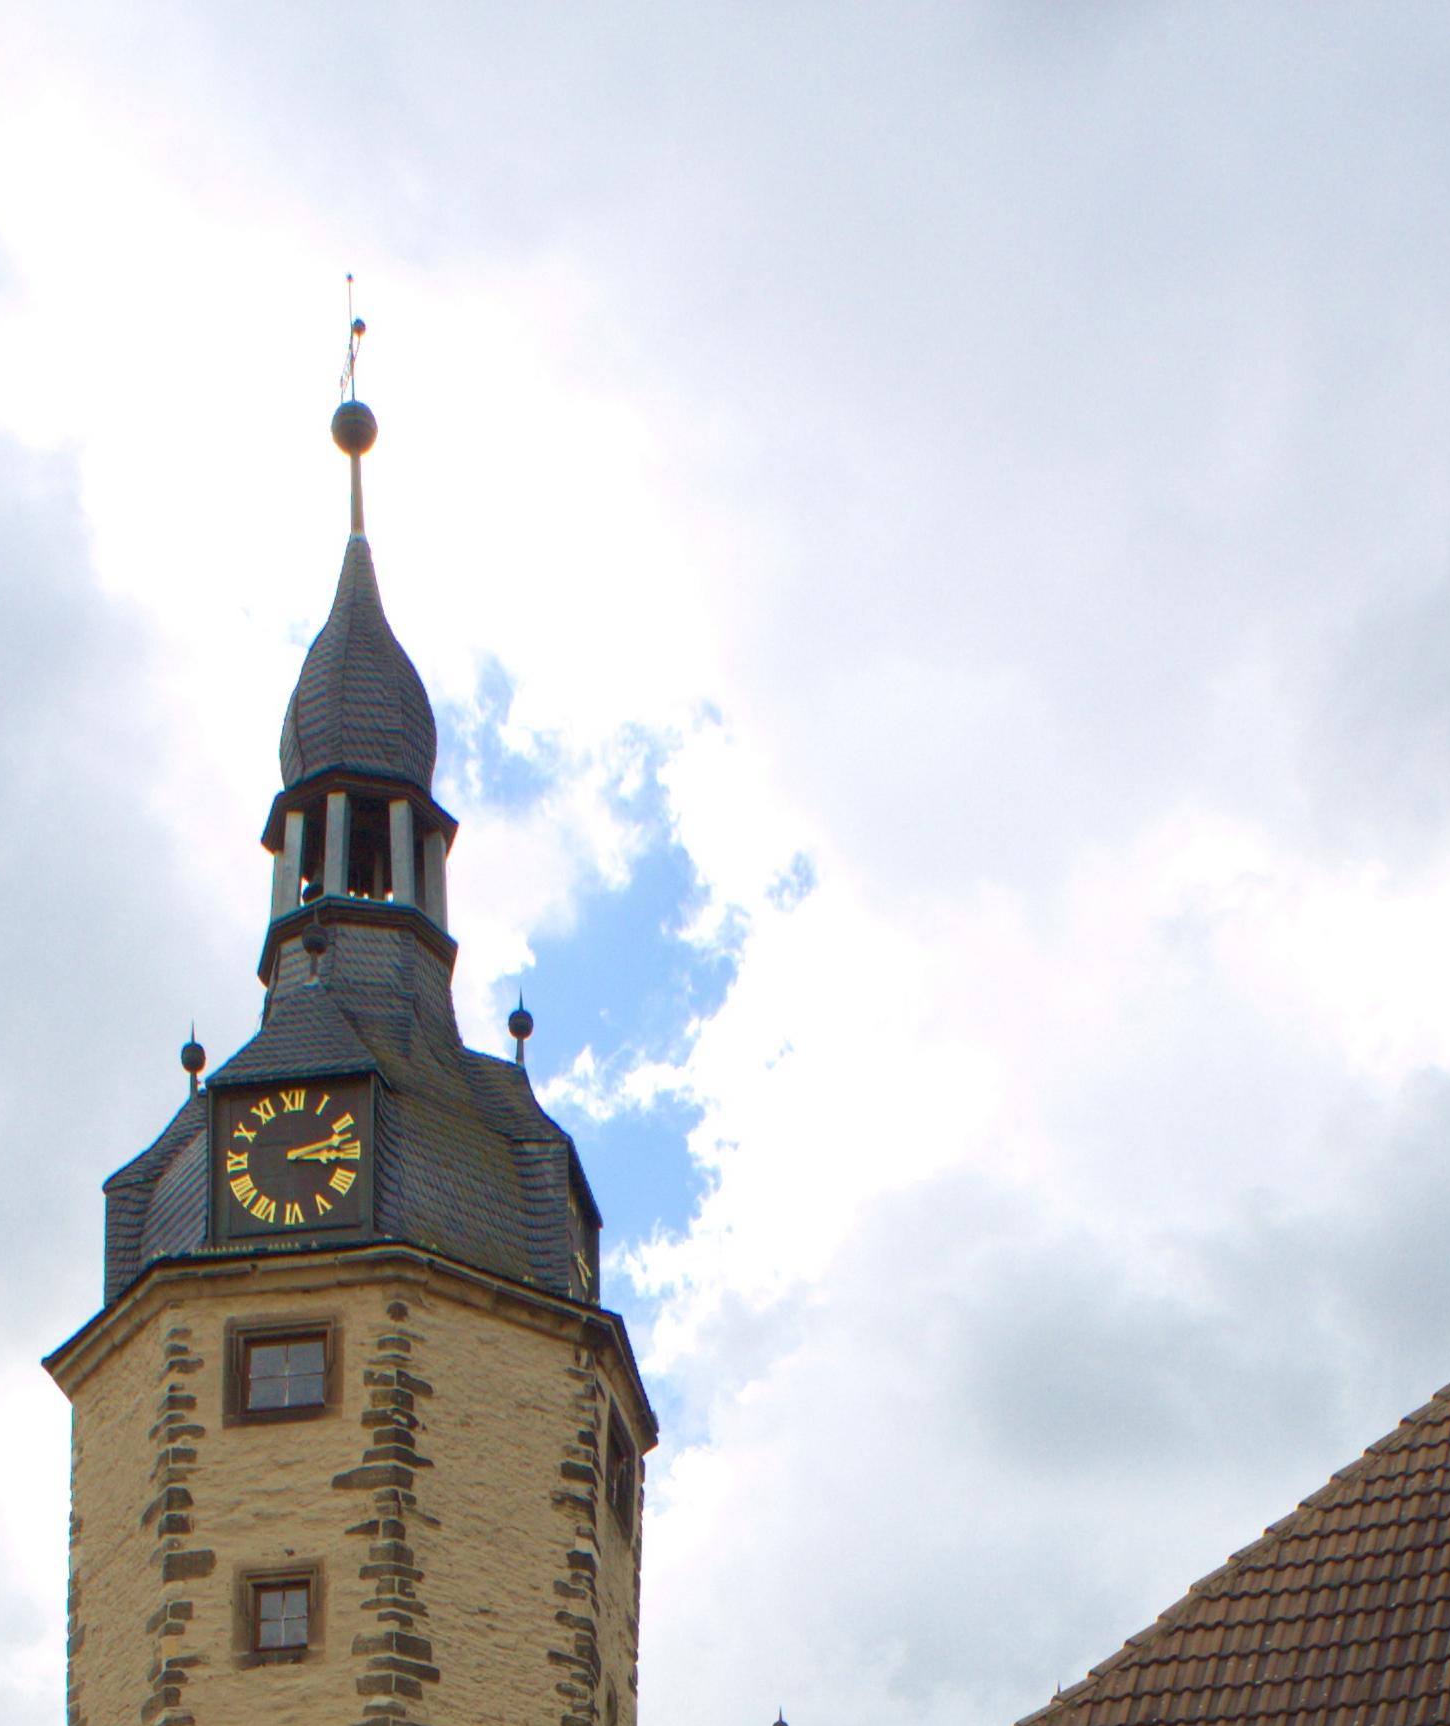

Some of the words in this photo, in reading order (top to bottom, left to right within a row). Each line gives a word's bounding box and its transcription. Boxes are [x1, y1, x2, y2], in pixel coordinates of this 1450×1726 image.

[251, 1097, 277, 1125] XI
[279, 1089, 306, 1112] XII
[315, 1094, 330, 1116] I
[233, 1121, 257, 1143] X
[332, 1112, 356, 1133] II
[226, 1150, 248, 1173] IX
[250, 1194, 277, 1223] VII
[285, 1202, 305, 1225] VI
[314, 1193, 333, 1216] V
